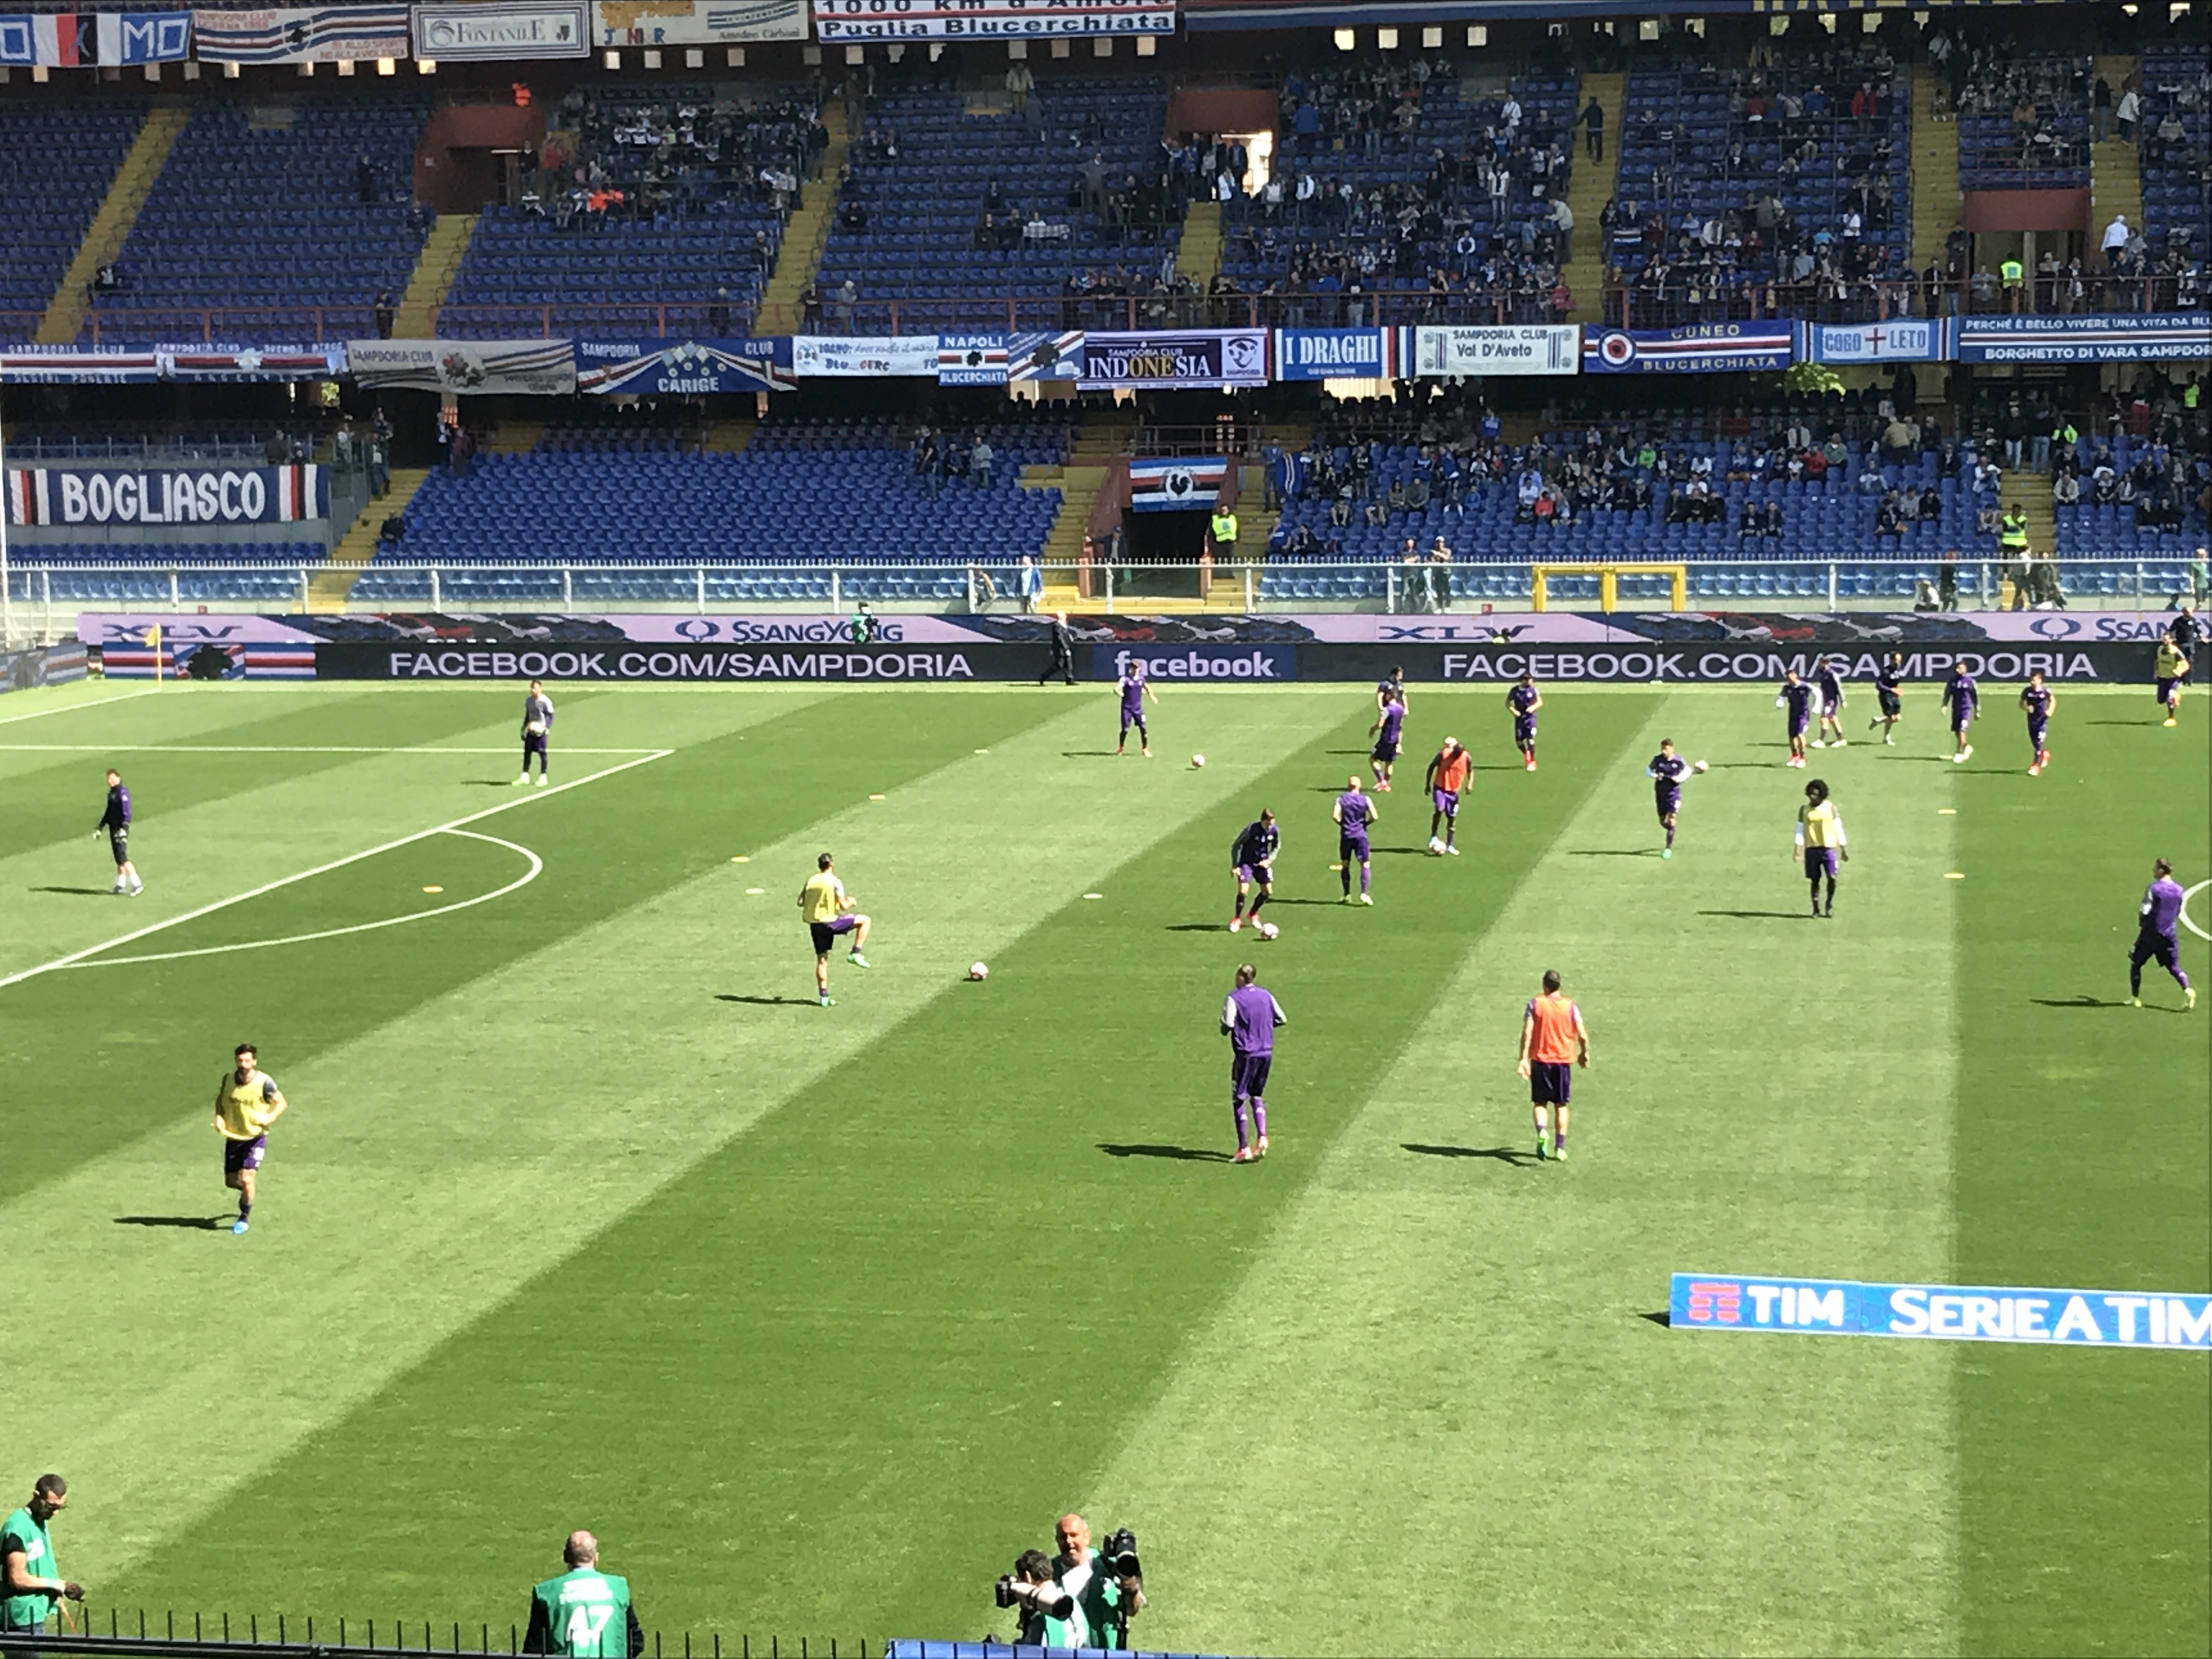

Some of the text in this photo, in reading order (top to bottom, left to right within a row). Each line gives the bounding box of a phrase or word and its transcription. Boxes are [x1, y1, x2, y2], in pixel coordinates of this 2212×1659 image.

[822, 0, 911, 14] 1000
[935, 0, 985, 10] km
[825, 14, 1169, 38] Puglia Blucerchiata
[1671, 324, 1740, 339] CUNEO
[1966, 318, 2012, 329] PERCHÉ
[2026, 320, 2064, 329] BELLO
[2066, 319, 2109, 328] VIVERE
[2113, 319, 2137, 328] UNA
[2142, 318, 2168, 327] VITA
[2172, 318, 2188, 326] DA
[945, 336, 1003, 347] NAPOLI
[1453, 329, 1548, 340] SAMPDORIA CLUB
[411, 351, 433, 362] CLUB
[581, 341, 774, 358] SAMPDORIA CLUB
[1285, 335, 1378, 364] I DRAGHI
[1457, 343, 1532, 357] Val D'Aveto
[1985, 347, 2074, 360] BORGHETTO
[2078, 348, 2093, 358] DI
[2097, 347, 2137, 358] VARA
[1088, 354, 1211, 379] INDONESIA
[1644, 356, 1778, 370] BLUCERCHIATA
[658, 377, 720, 393] CARIGE
[61, 471, 266, 522] BOGLIASCO
[391, 652, 973, 677] FACEBOOK.COM/SAMPDORIA
[1747, 1285, 1844, 1327] TIM
[1889, 1289, 2212, 1344] SERIE A TIM
[566, 1605, 614, 1649] 47
